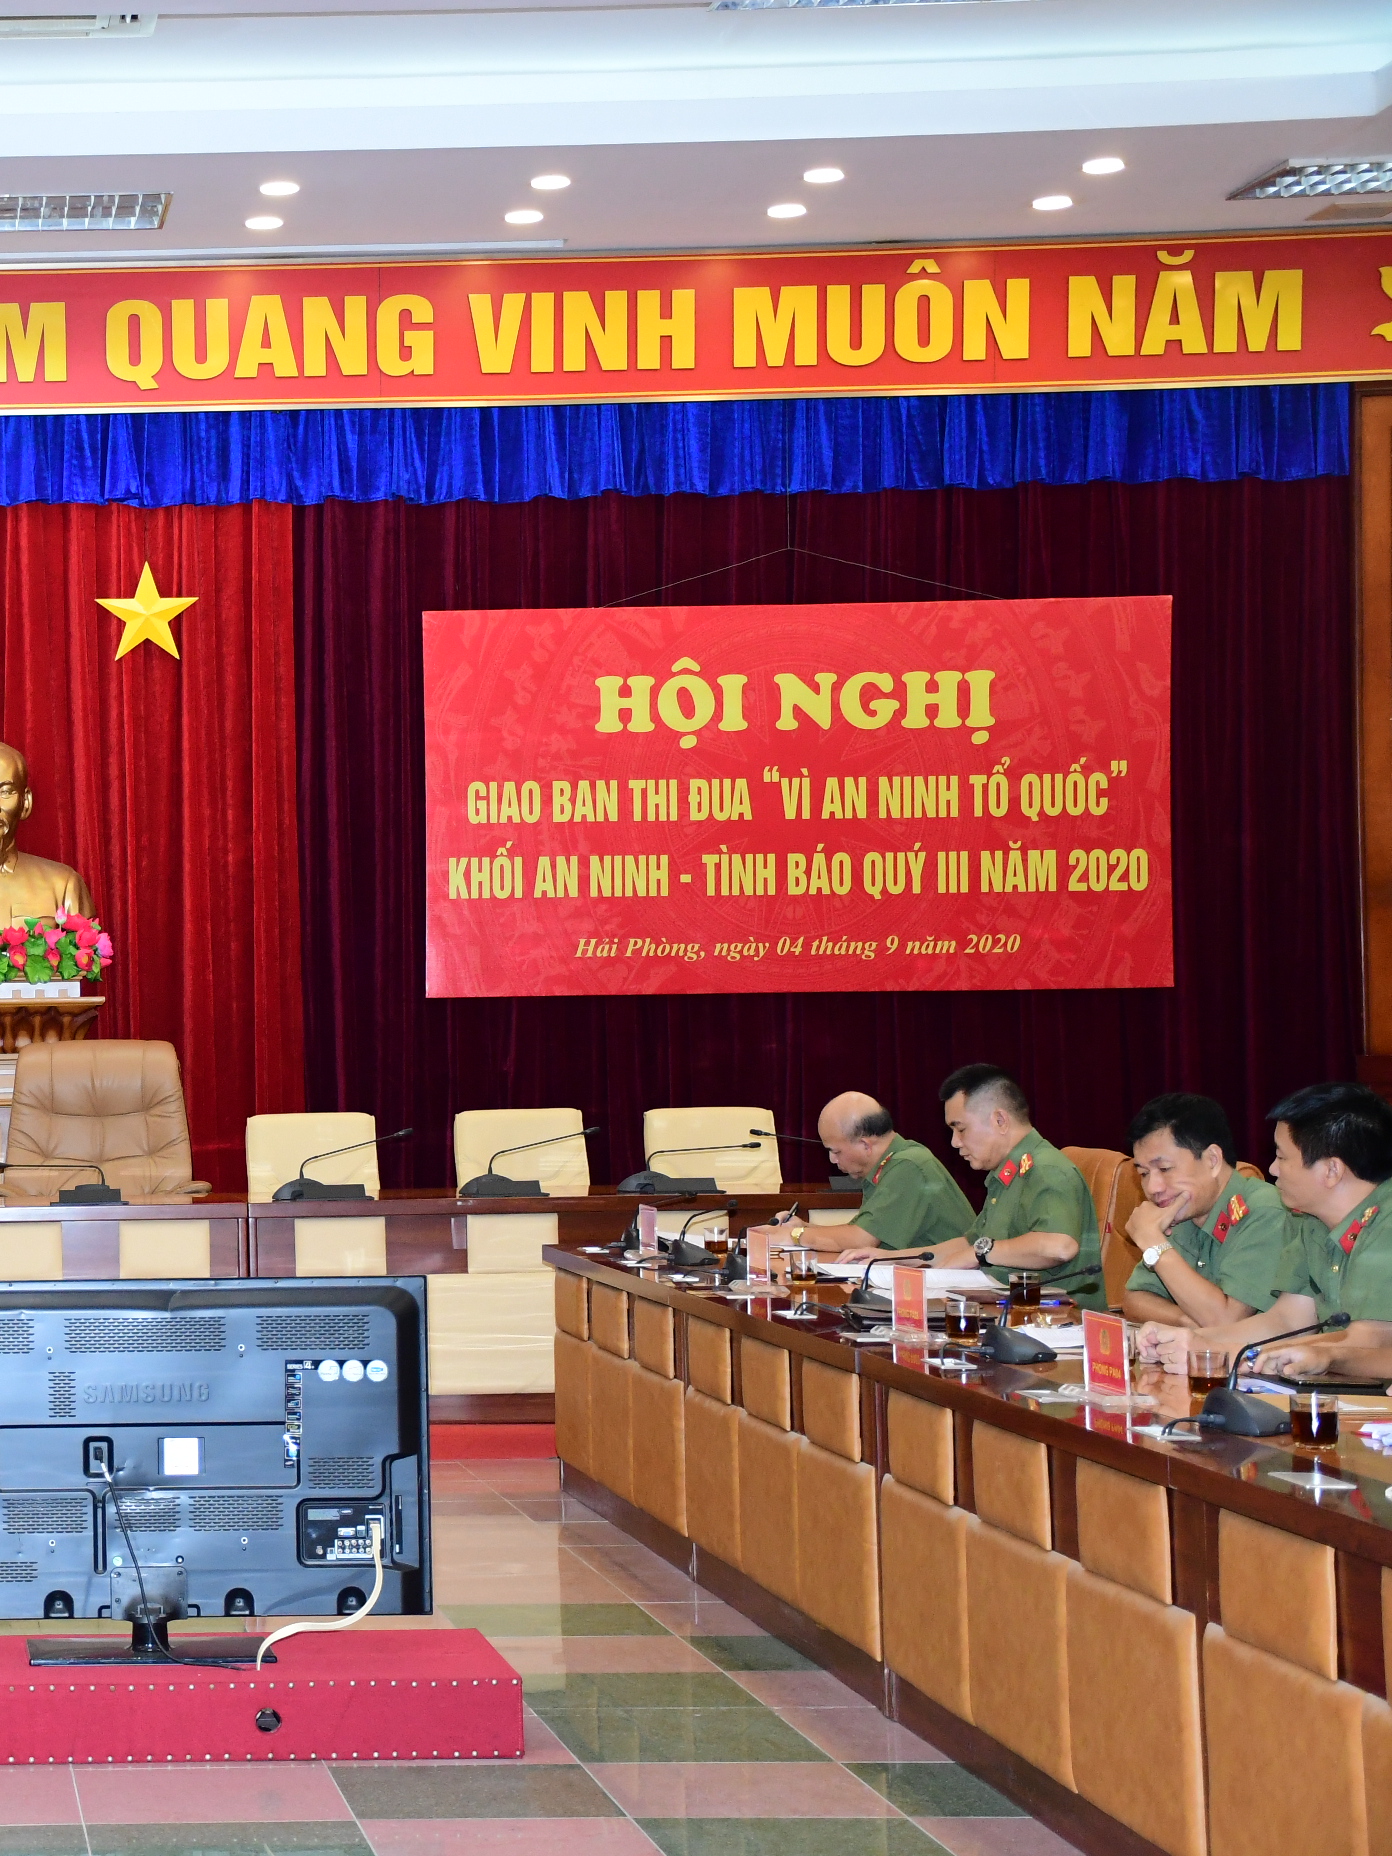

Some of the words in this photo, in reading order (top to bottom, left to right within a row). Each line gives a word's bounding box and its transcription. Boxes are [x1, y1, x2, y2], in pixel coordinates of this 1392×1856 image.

[106, 294, 434, 389] QUANG
[469, 289, 695, 373] VINH
[734, 259, 1029, 367] MUÔN
[1068, 250, 1302, 357] NĂM
[595, 657, 748, 749] HỘI
[774, 670, 995, 744] NGHỊ
[468, 781, 541, 824] GIAO
[552, 780, 618, 822] BAN
[629, 779, 678, 821] THI
[688, 778, 752, 821] ĐUA
[822, 777, 866, 819] AN
[879, 776, 958, 818] NINH
[970, 757, 1010, 817] TỔ
[449, 841, 523, 899] KHỐI
[534, 856, 578, 898] AN
[590, 855, 668, 897] NINH
[680, 874, 691, 882] -
[702, 845, 775, 896] TÌNH
[788, 844, 851, 895] BÁO
[864, 842, 924, 897] QUÝ
[938, 851, 968, 893] III
[981, 841, 1056, 892] NĂM
[1068, 849, 1148, 891] 2020
[576, 938, 618, 957] Hải
[626, 938, 705, 961] Phòng,
[715, 937, 769, 961] ngày
[777, 937, 804, 955] 04
[811, 936, 878, 959] tháng
[887, 936, 898, 954] 9
[906, 937, 956, 954] năm
[964, 934, 1020, 953] 2020
[83, 1382, 210, 1404] SAMSUNG
